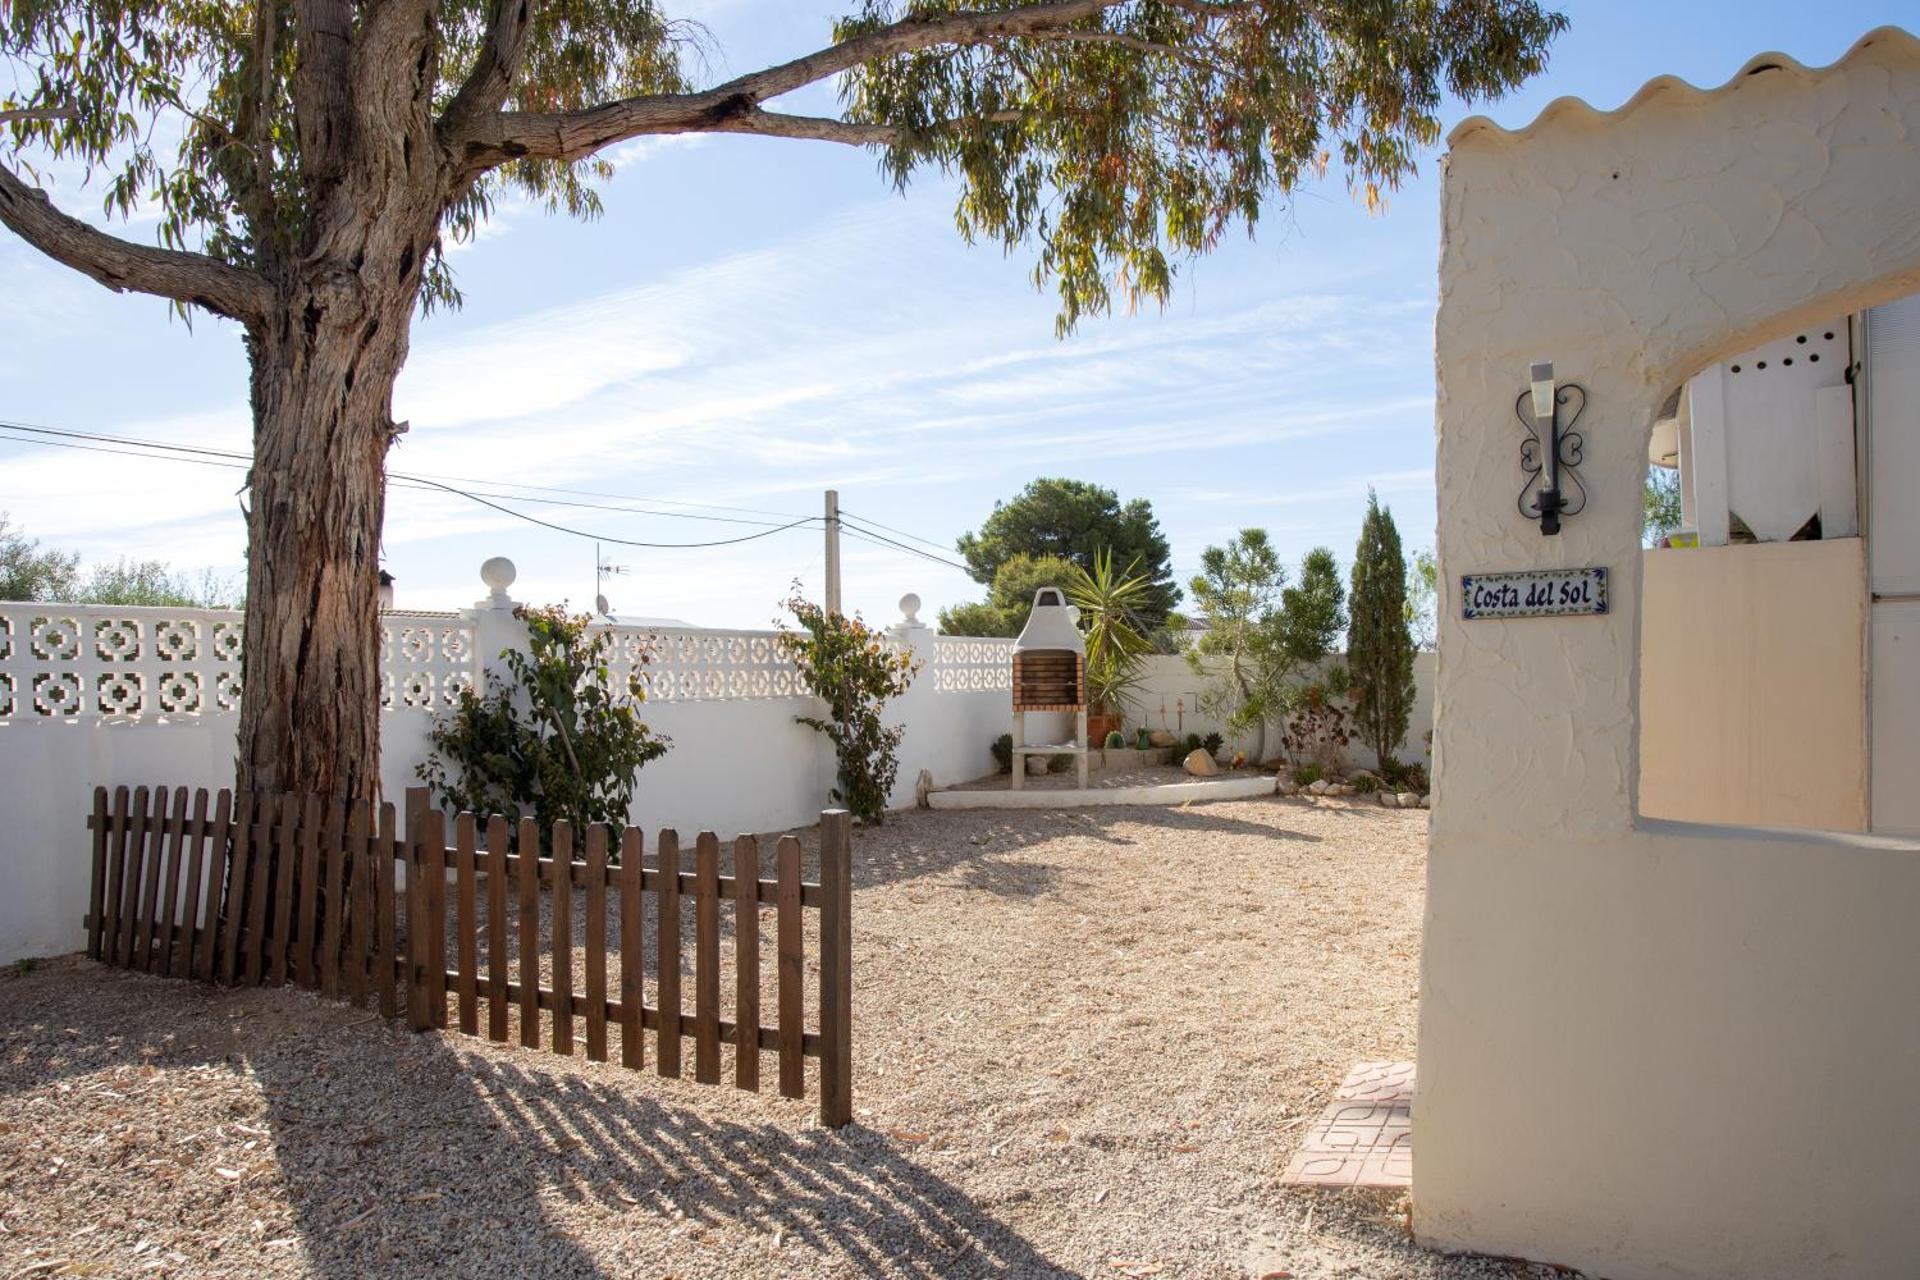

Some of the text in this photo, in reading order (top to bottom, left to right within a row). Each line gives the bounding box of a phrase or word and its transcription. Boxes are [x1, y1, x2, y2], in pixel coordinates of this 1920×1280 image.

[1474, 580, 1591, 608] Costa del Sol
